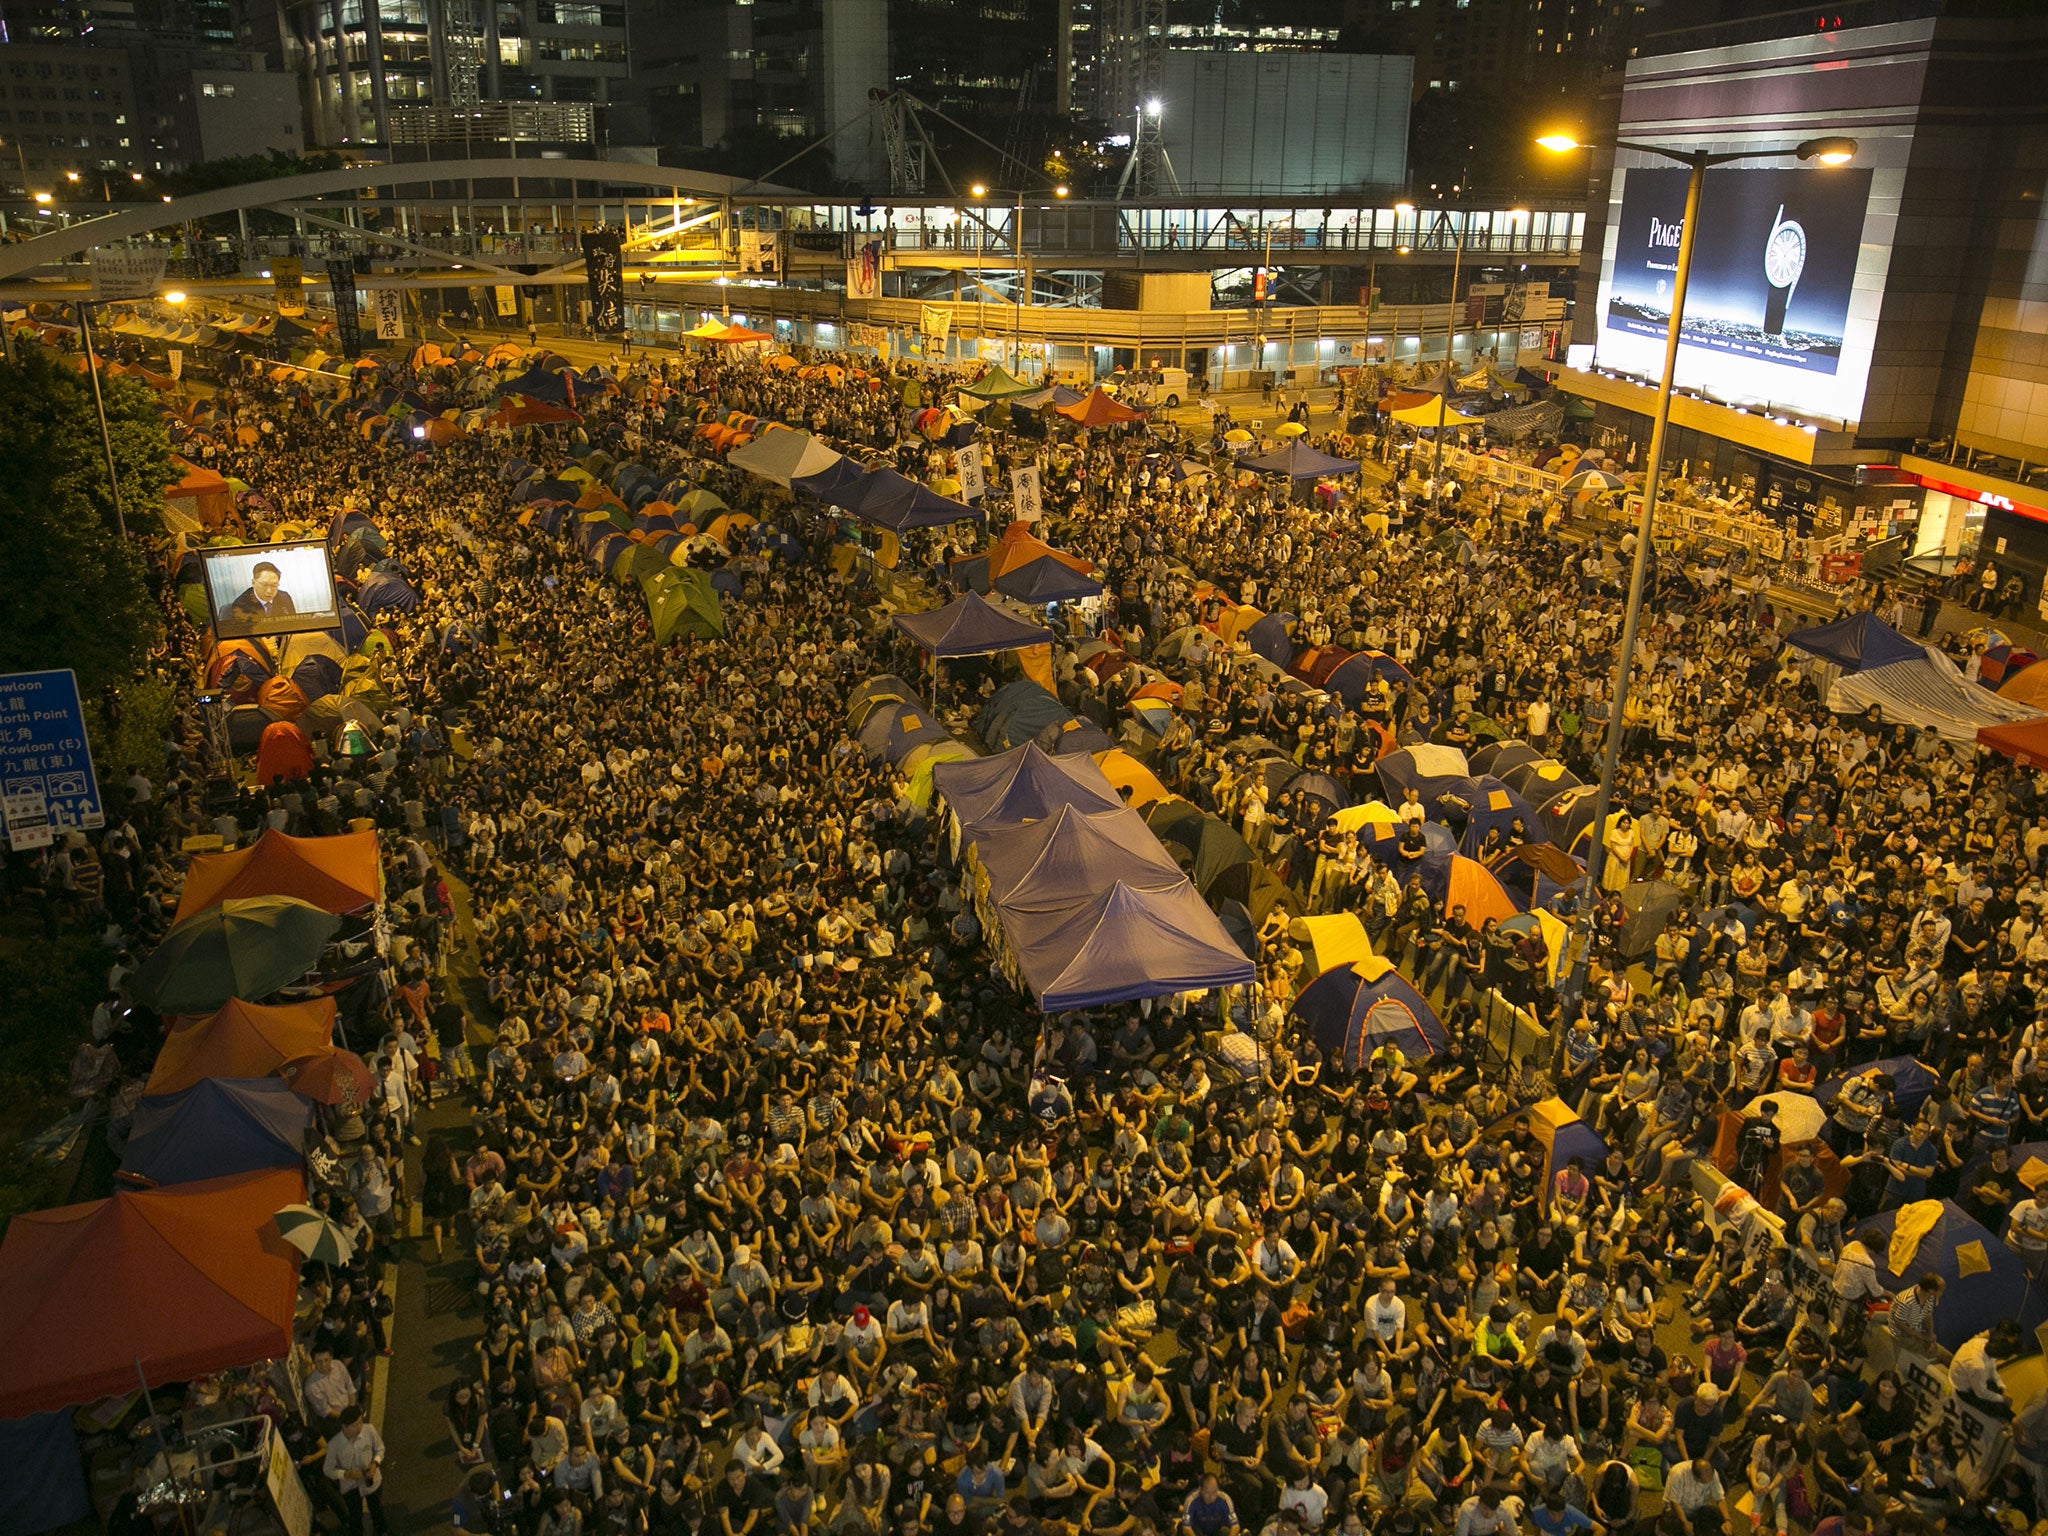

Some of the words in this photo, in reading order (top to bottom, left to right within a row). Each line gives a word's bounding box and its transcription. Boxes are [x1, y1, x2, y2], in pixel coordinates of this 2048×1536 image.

[592, 246, 618, 327] 政府失信
[1802, 501, 1818, 514] KFC
[0, 681, 43, 693] owloon
[34, 709, 69, 720] Point
[0, 727, 33, 743] 北角
[0, 743, 55, 754] Kowloon
[59, 737, 82, 751] (E)
[4, 754, 74, 774] 九龍(東)
